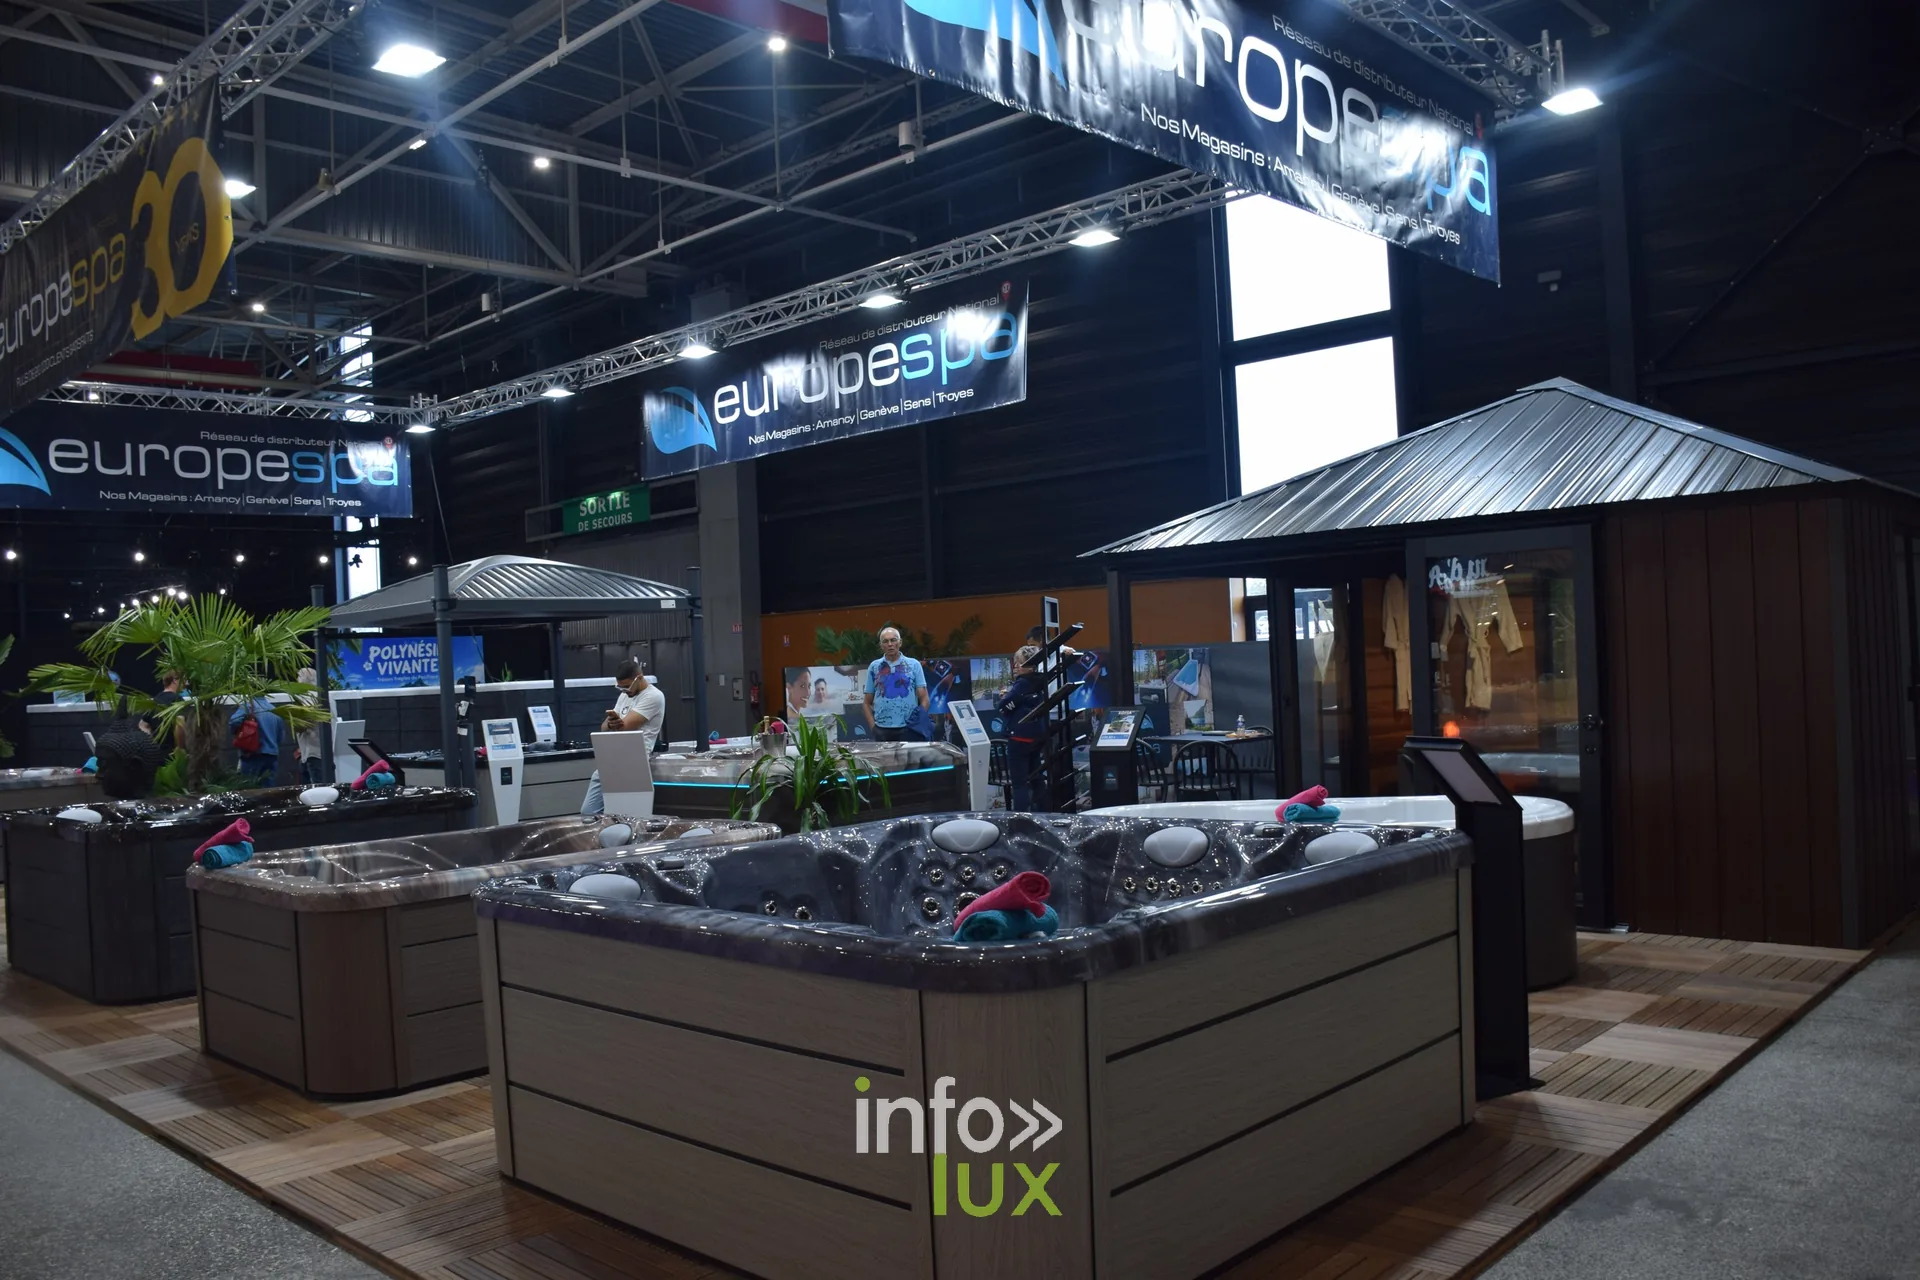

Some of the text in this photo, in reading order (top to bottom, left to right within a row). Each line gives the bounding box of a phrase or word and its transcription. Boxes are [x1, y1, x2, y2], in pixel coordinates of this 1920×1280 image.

[1272, 15, 1474, 136] Réseau de distributeur National
[1141, 102, 1180, 134] Nos
[1182, 119, 1265, 168] Magasins
[1385, 206, 1419, 230] Sens
[1423, 218, 1461, 245] Troyes
[820, 334, 860, 351] Réseau
[861, 328, 875, 341] de
[877, 310, 946, 336] distributeur
[749, 434, 765, 445] Nos
[766, 423, 811, 439] Magasins
[816, 414, 856, 430] Amancy
[860, 404, 899, 420] Genève
[904, 397, 931, 411] Sens
[936, 388, 974, 404] Troyes
[200, 431, 248, 442] Réseau
[250, 434, 265, 443] de
[267, 436, 336, 447] distributeur
[49, 438, 398, 493] europespa
[100, 490, 126, 500] Nos
[129, 491, 188, 503] Magasins
[195, 494, 241, 505] Amancy
[246, 494, 288, 504] Genève
[294, 496, 321, 506] Sens
[327, 497, 361, 507] Troyes
[579, 491, 630, 516] SORTIE
[578, 512, 632, 532] DE SECOURS
